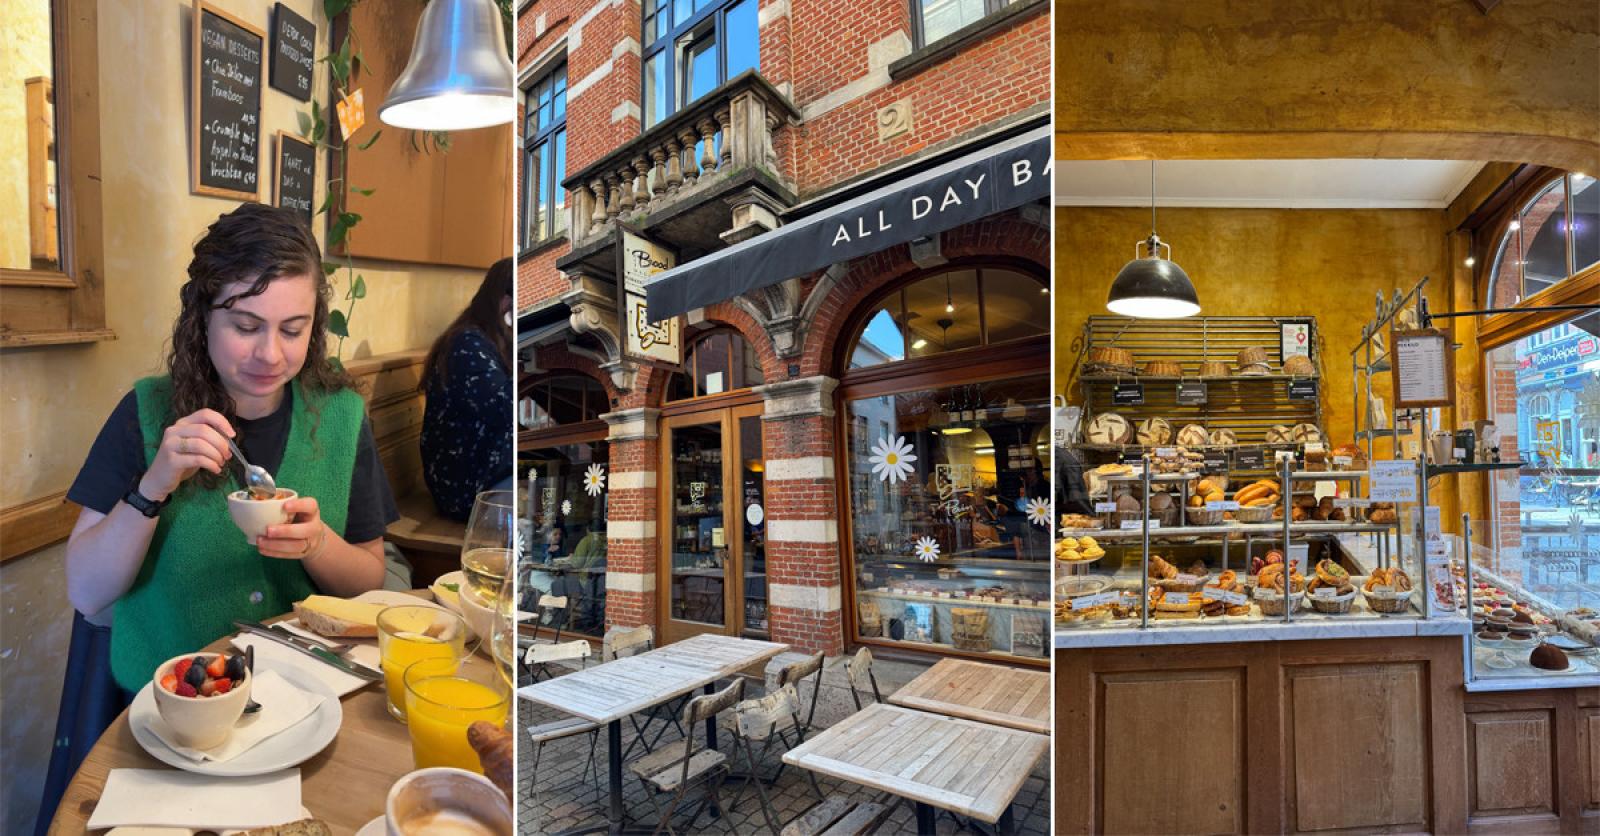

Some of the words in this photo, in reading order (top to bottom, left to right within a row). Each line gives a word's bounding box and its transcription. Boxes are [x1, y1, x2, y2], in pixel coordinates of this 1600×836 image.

[203, 29, 226, 50] VEGAN
[229, 40, 260, 65] DESSERTS
[880, 108, 909, 141] 2
[832, 210, 892, 247] ALL
[911, 173, 986, 221] DAY
[632, 250, 669, 270] Brood
